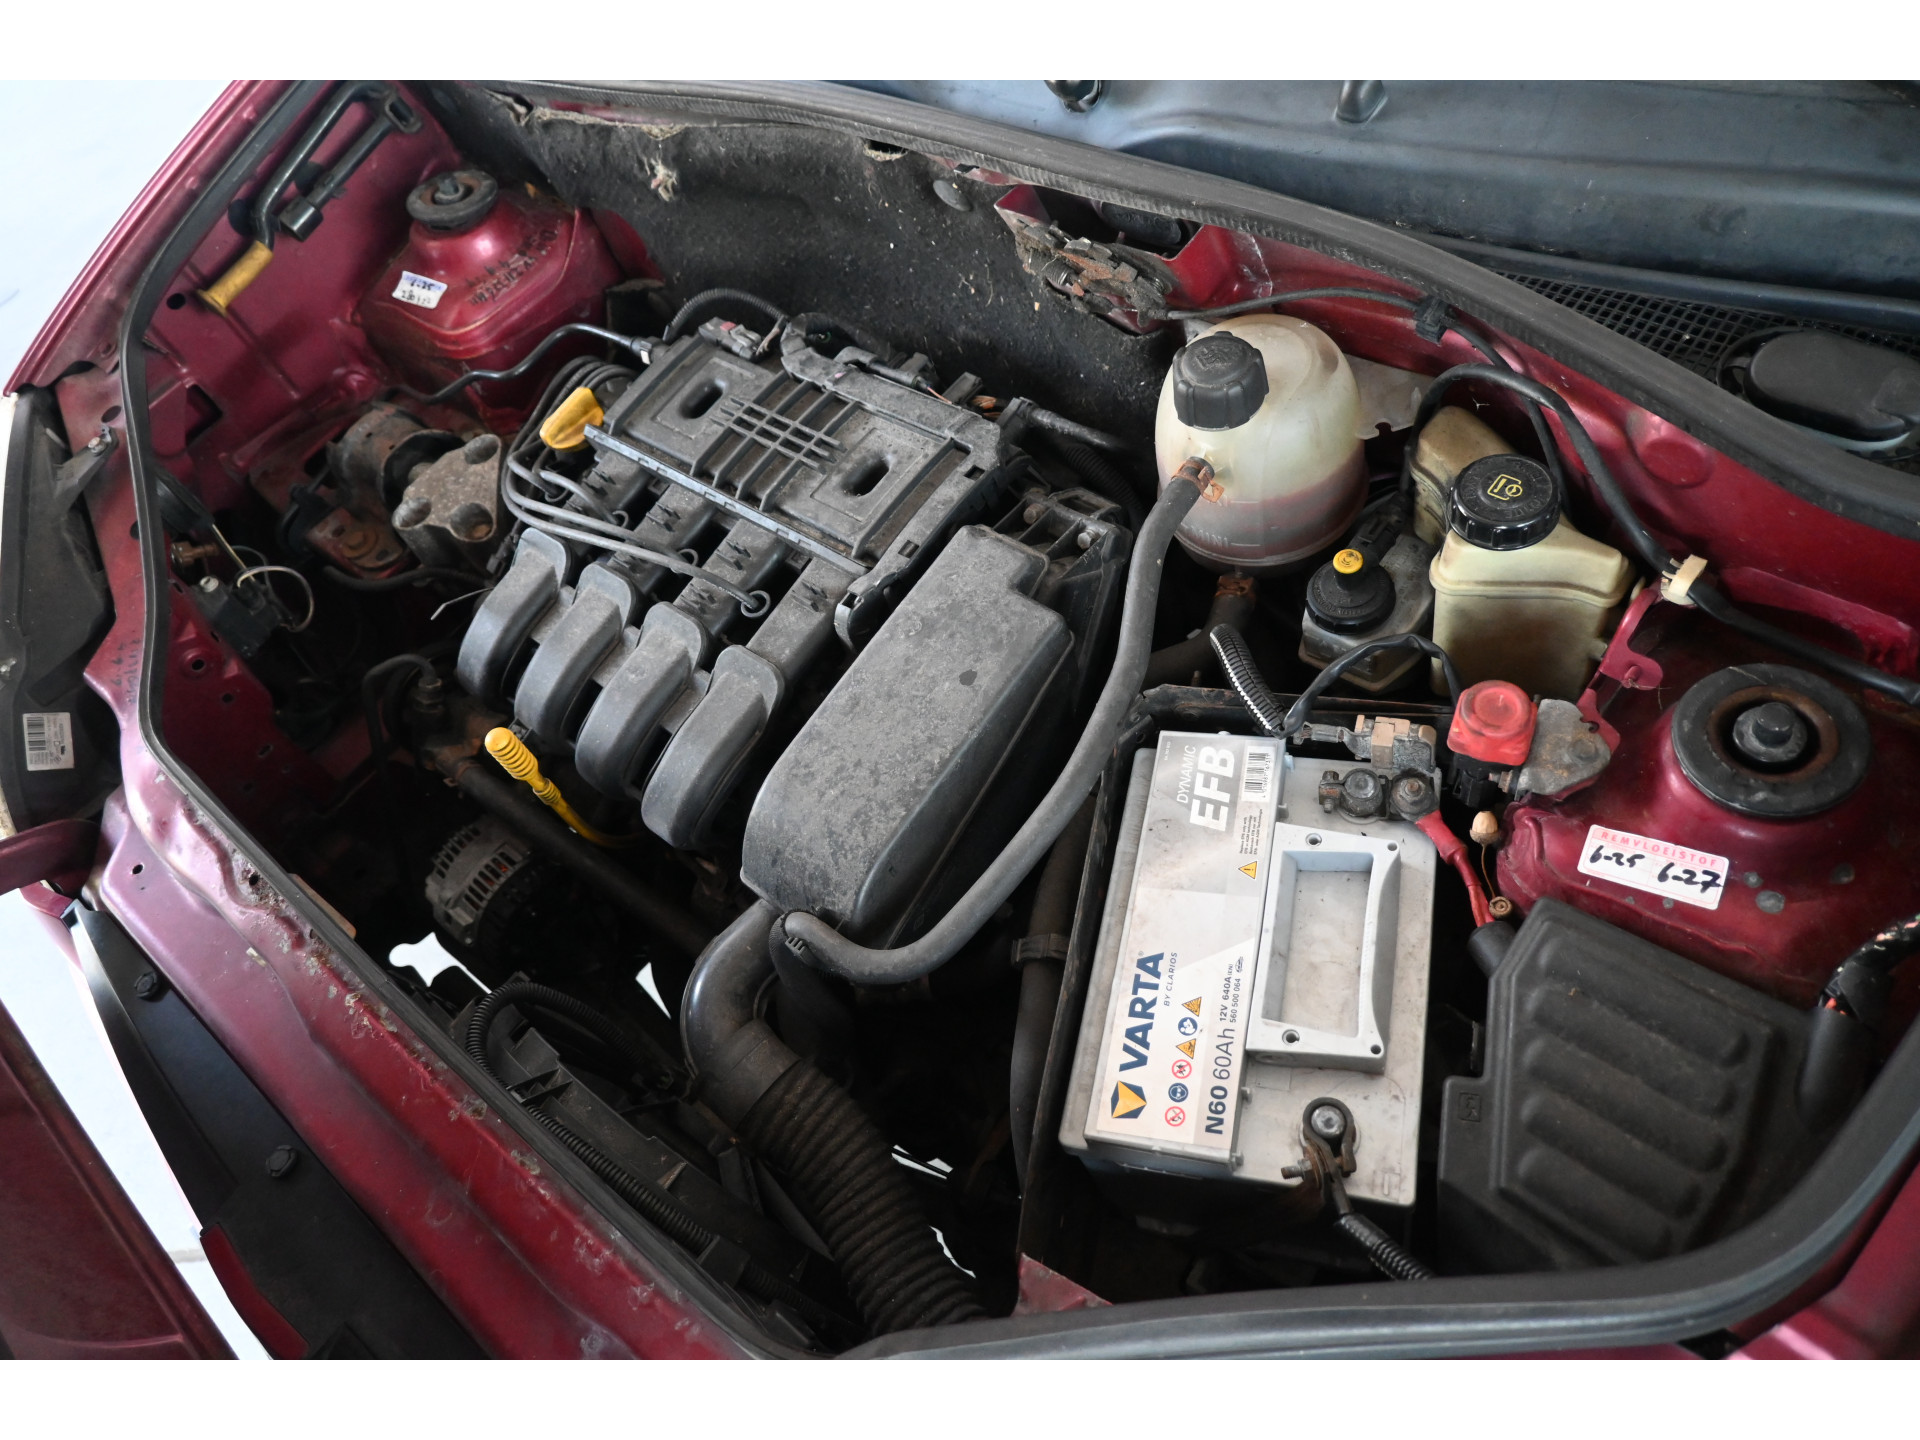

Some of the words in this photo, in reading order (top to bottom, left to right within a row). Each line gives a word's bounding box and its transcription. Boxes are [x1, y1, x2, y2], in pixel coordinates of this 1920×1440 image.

[1176, 745, 1196, 804] DYNAMIC
[1189, 746, 1235, 831] EFB
[1589, 845, 1646, 868] 6-25
[1600, 831, 1718, 867] REMVLOEISTOF
[1657, 862, 1723, 894] 6-27
[1166, 951, 1178, 992] CLARIOS
[1233, 978, 1242, 992] 064
[1163, 993, 1172, 1007] BY
[1222, 976, 1232, 1001] 640A
[1231, 993, 1240, 1009] 500
[1119, 952, 1165, 1072] VARTA
[1219, 1004, 1229, 1021] 12V
[1229, 1010, 1238, 1023] 560
[1212, 1027, 1235, 1080] 60Ah
[1204, 1085, 1228, 1135] N60
